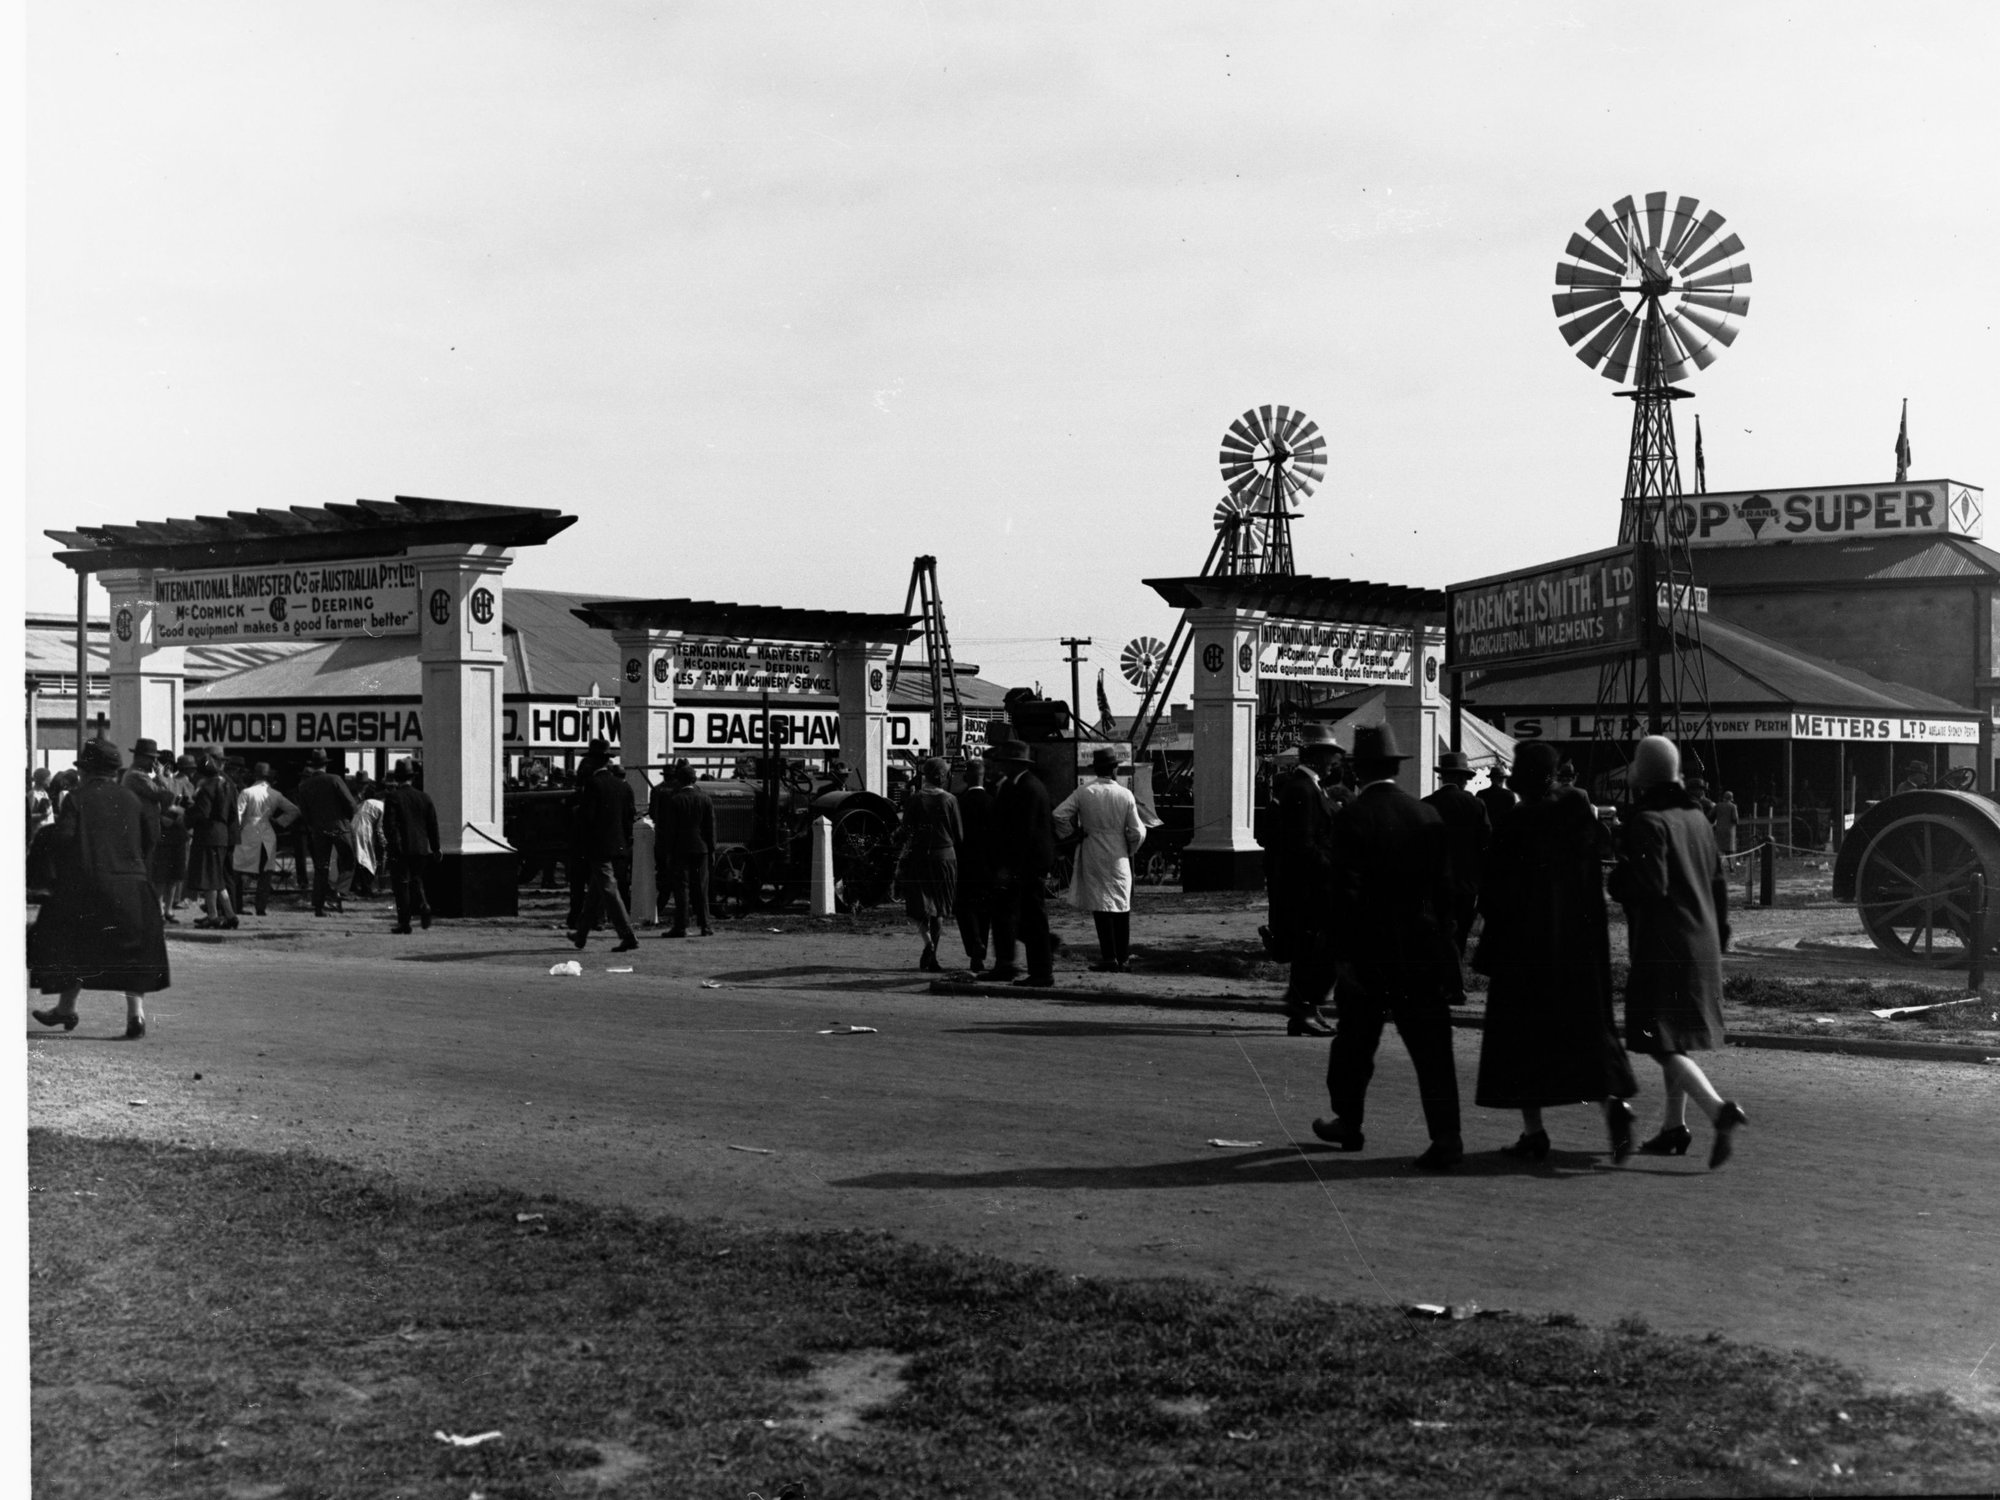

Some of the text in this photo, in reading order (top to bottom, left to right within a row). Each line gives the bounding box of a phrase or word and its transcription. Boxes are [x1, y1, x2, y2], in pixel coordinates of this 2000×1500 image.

[1737, 508, 1778, 519] BRAND
[1784, 490, 1935, 534] SUPER
[156, 578, 232, 603] INTERNATIONAL
[232, 574, 292, 598] HARVESTER
[321, 567, 379, 593] AUSTRALIA
[312, 596, 374, 614] DEERING
[188, 621, 239, 641] equipment
[243, 619, 278, 634] makes
[283, 622, 290, 632] a
[294, 616, 322, 637] good
[326, 614, 367, 630] farmer
[1261, 623, 1313, 647] INTERNATIONAL
[1469, 616, 1605, 657] AGRICULTURAL IMPLEMENTS
[766, 661, 810, 674] DEERING
[1360, 652, 1394, 668] DEERING
[705, 672, 734, 687] FARM
[1280, 663, 1315, 677] equipment
[1316, 665, 1338, 677] makes
[1345, 667, 1360, 680] good
[1755, 719, 1788, 732] PERTH
[1795, 714, 1890, 739] METTERS
